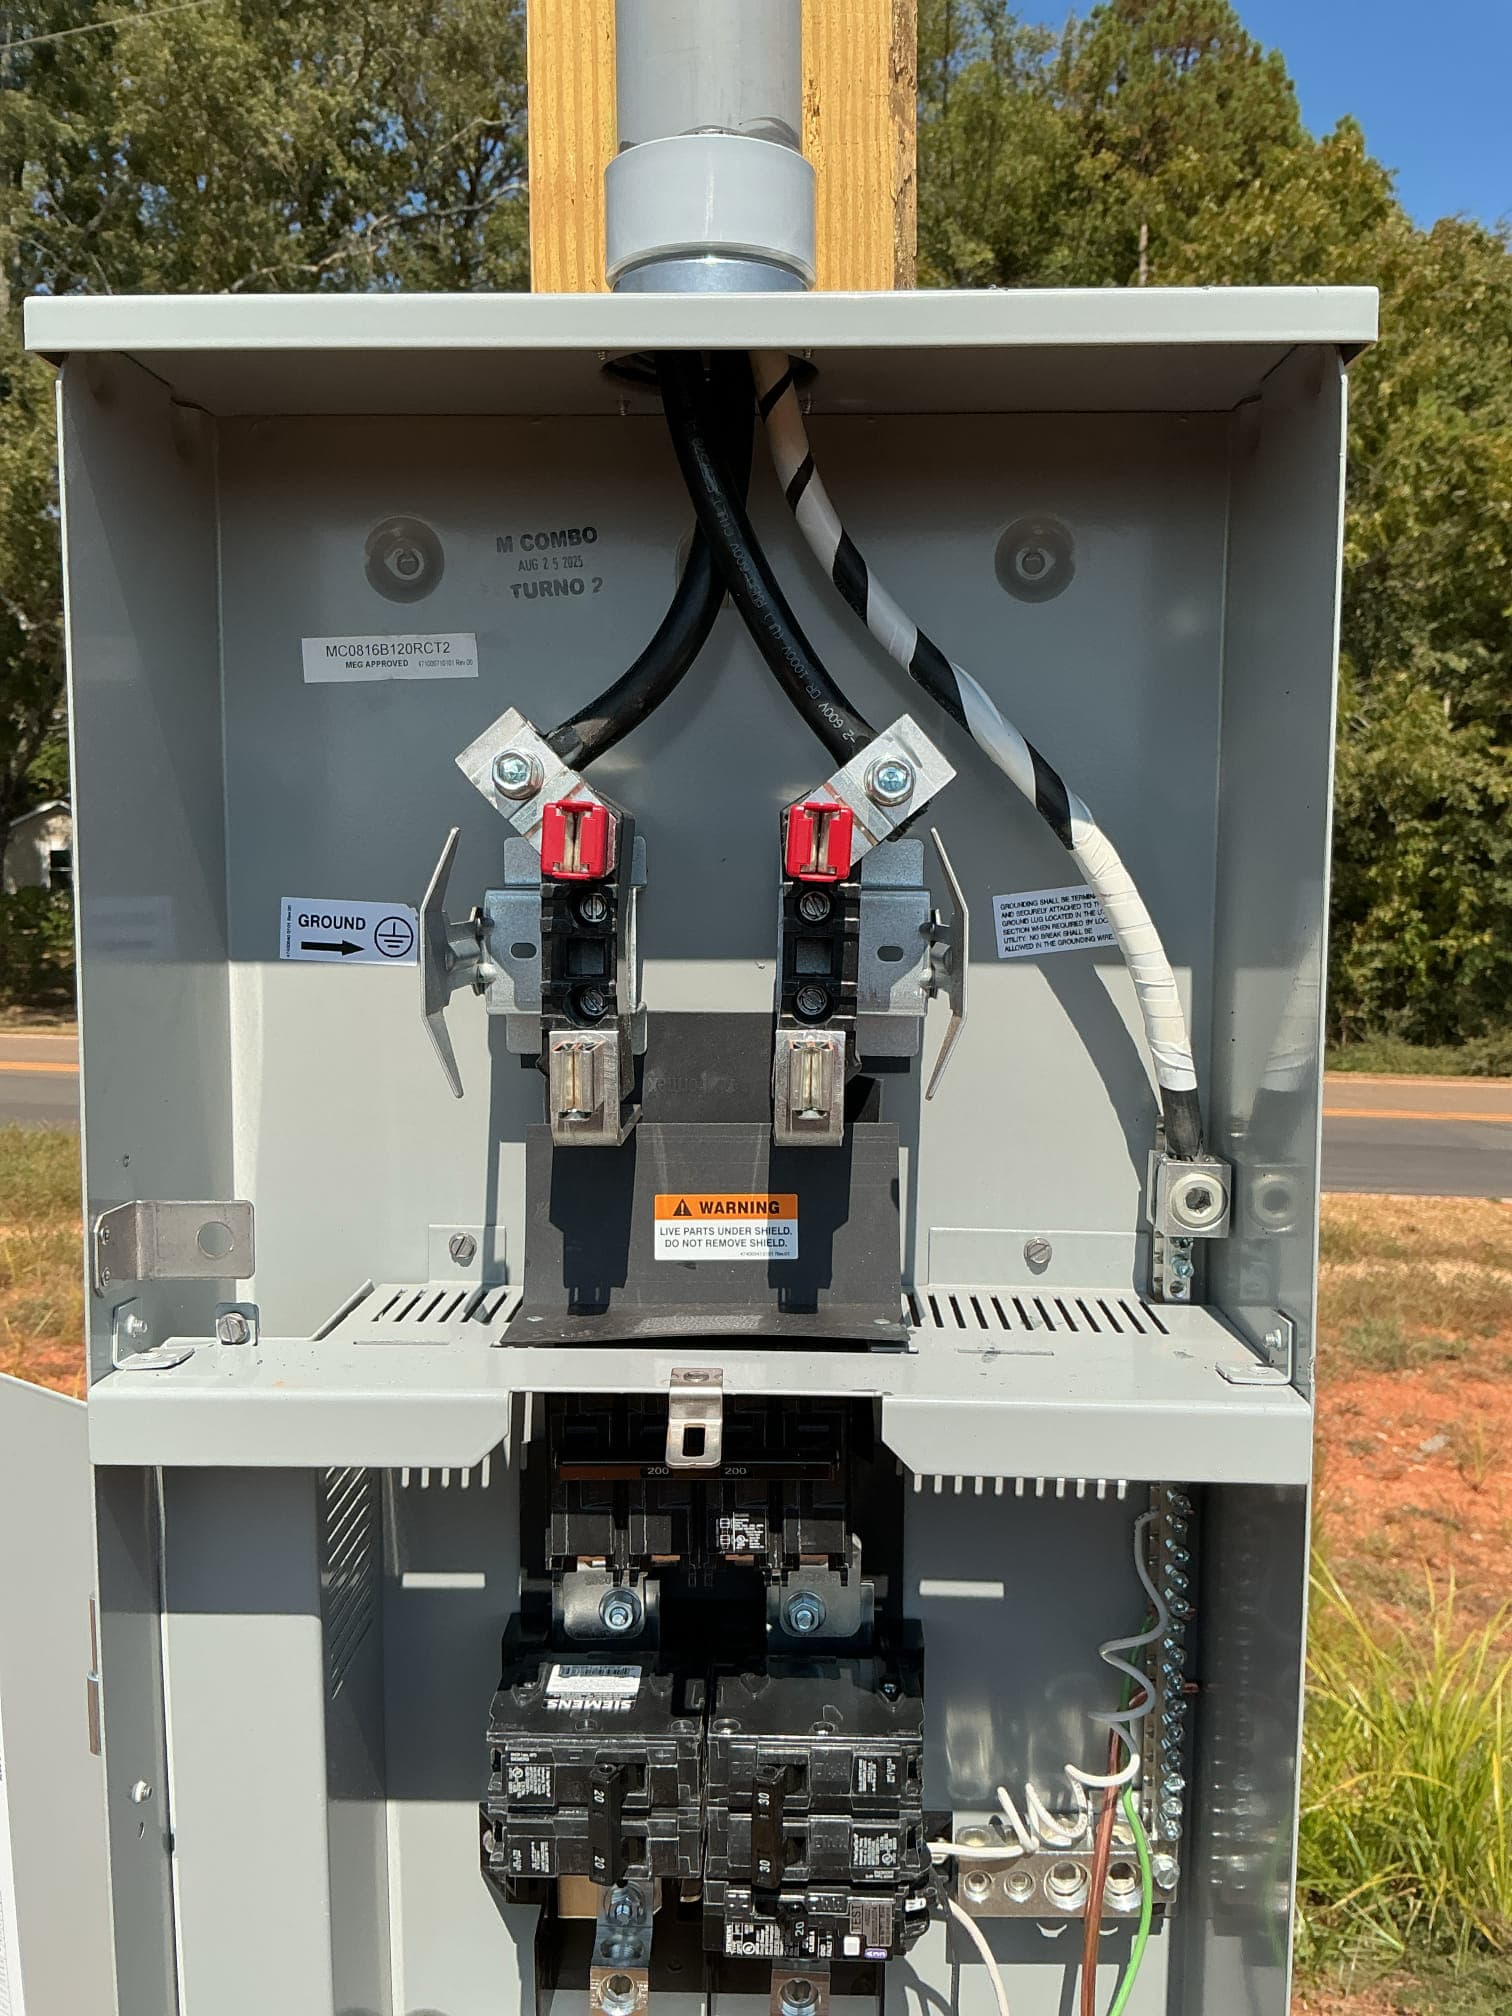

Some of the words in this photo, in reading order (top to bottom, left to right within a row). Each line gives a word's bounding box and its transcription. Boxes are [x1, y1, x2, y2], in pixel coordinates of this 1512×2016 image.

[496, 535, 514, 553] M
[519, 526, 598, 552] COMBO
[518, 558, 539, 572] AUG
[563, 555, 584, 568] 2025
[510, 577, 585, 599] TURNO
[591, 576, 604, 594] 2
[325, 641, 450, 658] MC0816B120RCT2
[345, 660, 364, 669] MEG
[365, 659, 409, 668] APPROVED
[782, 646, 809, 679] 1000V
[818, 702, 843, 729] 600V
[1000, 900, 1038, 910] GROUNDING
[1040, 898, 1059, 906] SHALL
[1001, 911, 1014, 919] AND
[1016, 908, 1047, 917] SECURELY
[1049, 904, 1081, 913] ATTACHED
[298, 913, 366, 930] GROUND
[1002, 918, 1029, 927] GROUND
[1030, 916, 1043, 924] LUG
[1045, 912, 1073, 922] LOCATED
[1084, 909, 1096, 917] THE
[1002, 927, 1030, 936] SECTION
[1031, 924, 1051, 933] WHEN
[1052, 920, 1084, 930] REQUIRED
[1029, 933, 1039, 941] NO
[1040, 931, 1061, 940] BREAK
[1063, 928, 1083, 937] SHALL
[1004, 943, 1034, 953] ALLOWED
[1044, 940, 1057, 948] THE
[1057, 935, 1096, 946] GROUNDING
[699, 1200, 781, 1215] WARNING
[660, 1226, 681, 1236] LIVE
[683, 1226, 715, 1236] PARTS
[717, 1226, 753, 1236] UNDER
[755, 1226, 793, 1236] SHIELD.
[664, 1238, 680, 1248] DO
[682, 1238, 701, 1248] NOT
[705, 1238, 747, 1248] REMOVE
[749, 1238, 788, 1248] SHIELD.
[647, 1467, 670, 1475] 200
[724, 1467, 747, 1475] 200
[546, 1699, 632, 1711] SIEMENS
[593, 1789, 605, 1804] 20
[758, 1792, 770, 1806] 30
[594, 1855, 605, 1870] 20
[759, 1859, 771, 1873] 30
[852, 1905, 861, 1933] TEST
[794, 1921, 805, 1937] 20
